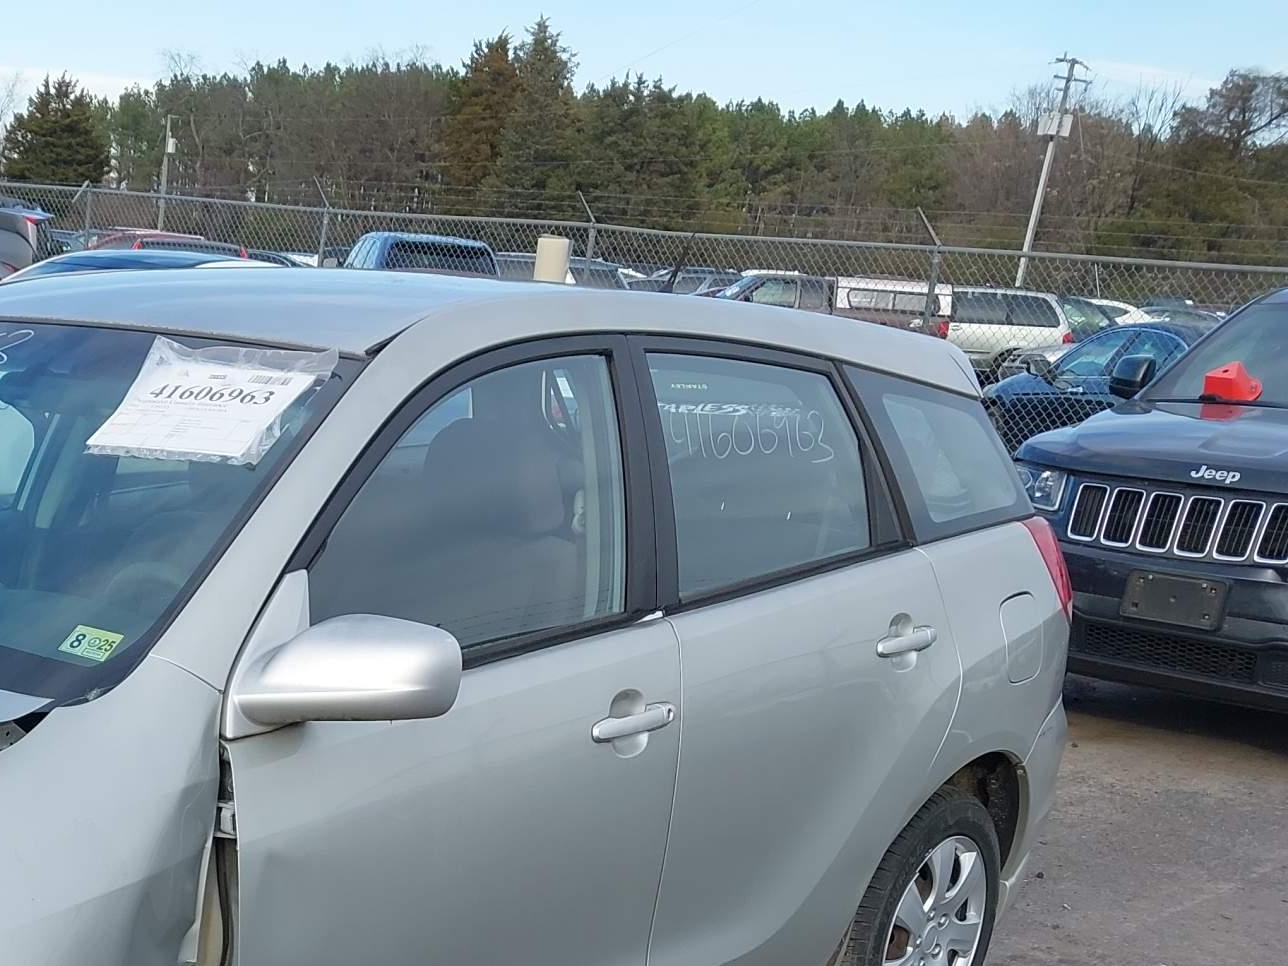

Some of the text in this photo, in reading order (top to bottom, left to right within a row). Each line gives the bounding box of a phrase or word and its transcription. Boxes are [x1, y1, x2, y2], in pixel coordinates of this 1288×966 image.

[149, 383, 276, 406] 41606963
[669, 409, 834, 463] 41606963
[1190, 465, 1241, 484] Jeep
[69, 633, 117, 652] 8 25
